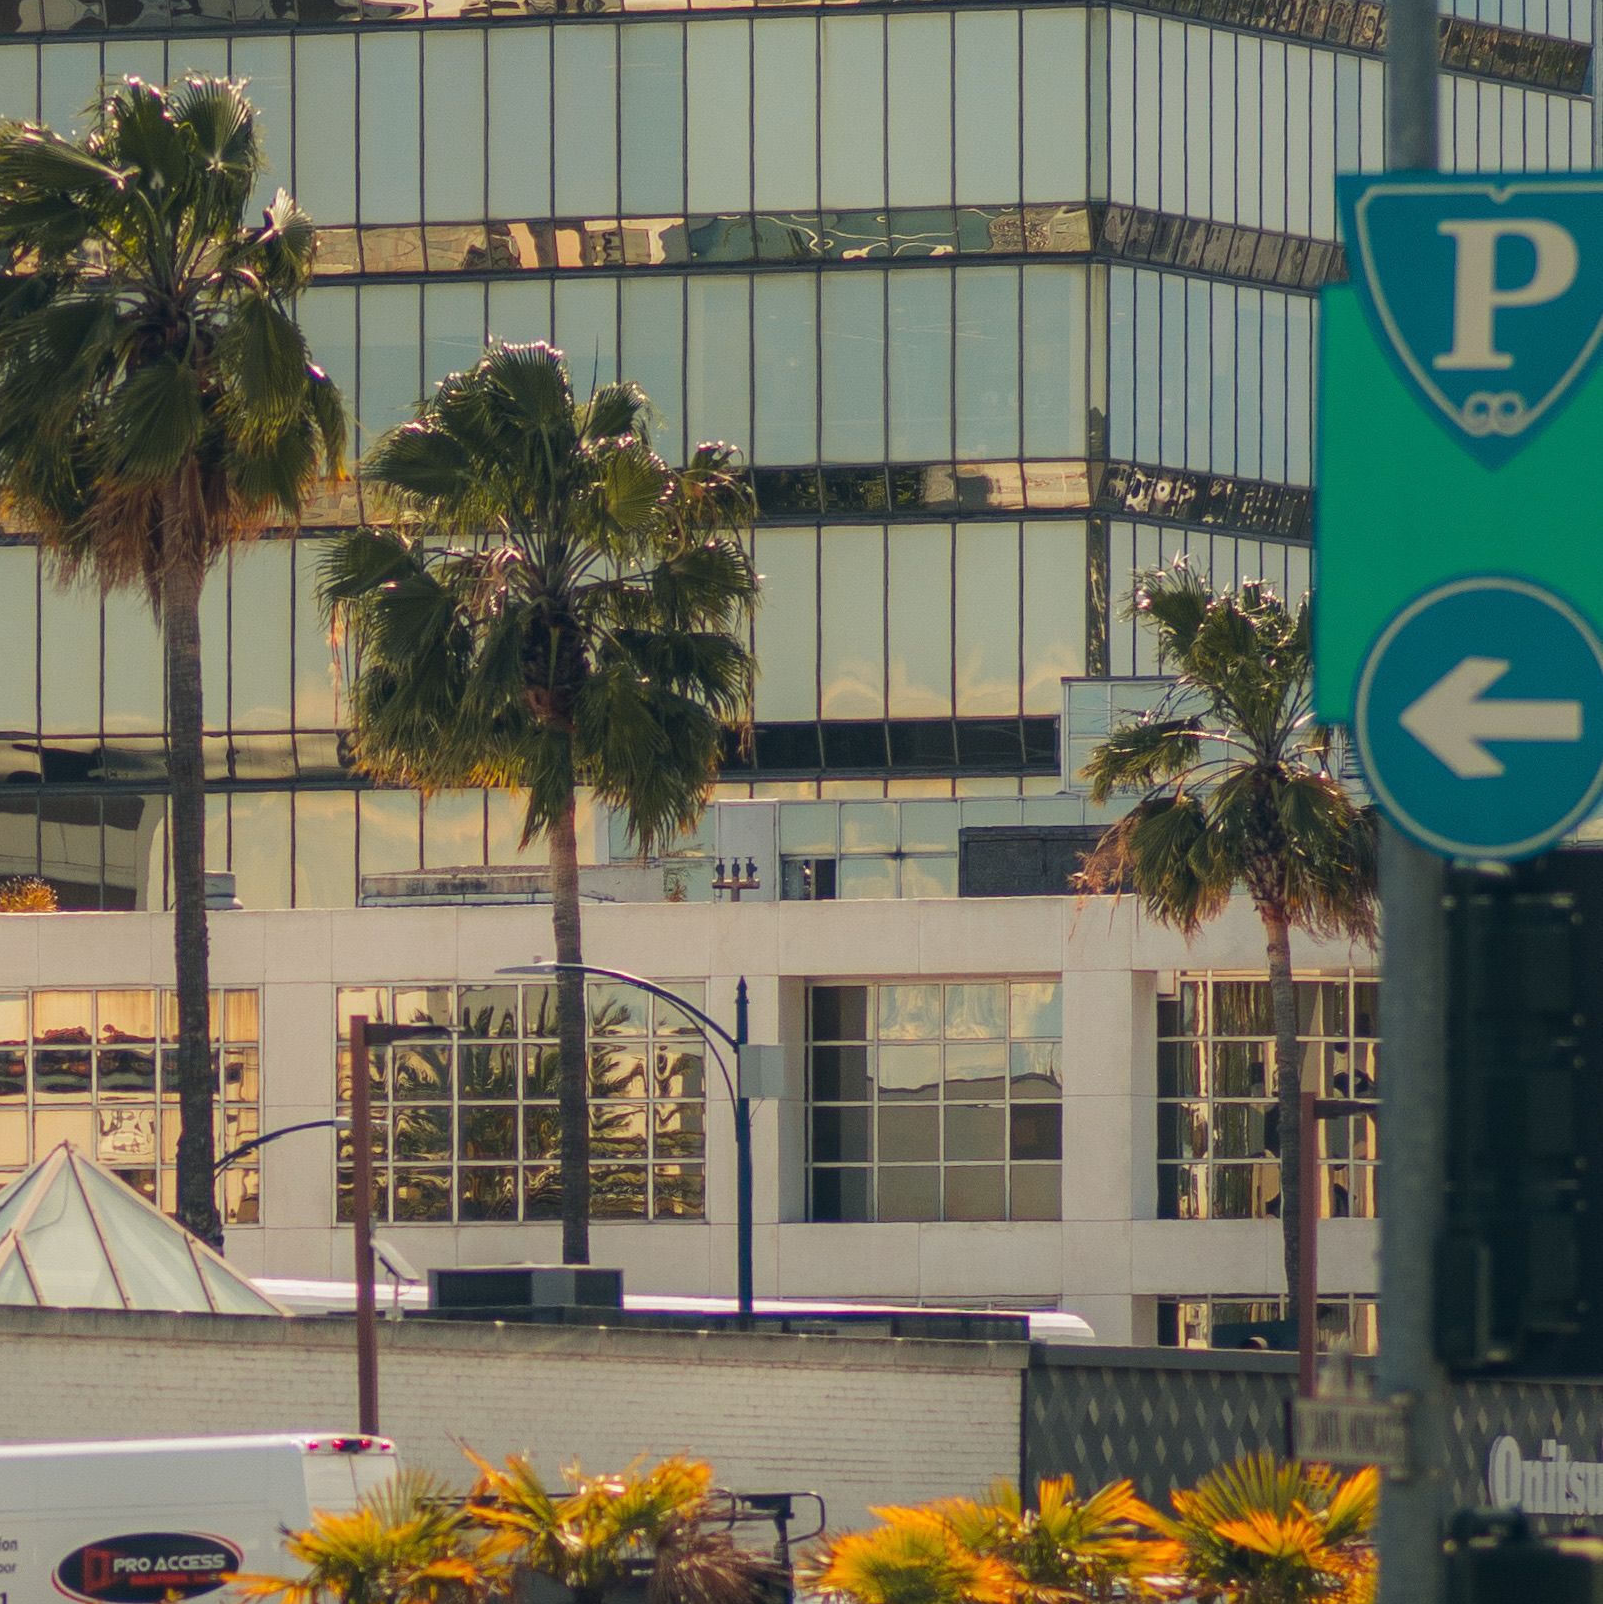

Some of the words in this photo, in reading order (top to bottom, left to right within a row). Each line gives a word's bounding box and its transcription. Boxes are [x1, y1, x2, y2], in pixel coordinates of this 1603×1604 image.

[1433, 220, 1578, 369] P
[113, 1557, 152, 1573] PRO
[153, 1553, 226, 1572] ACCESS
